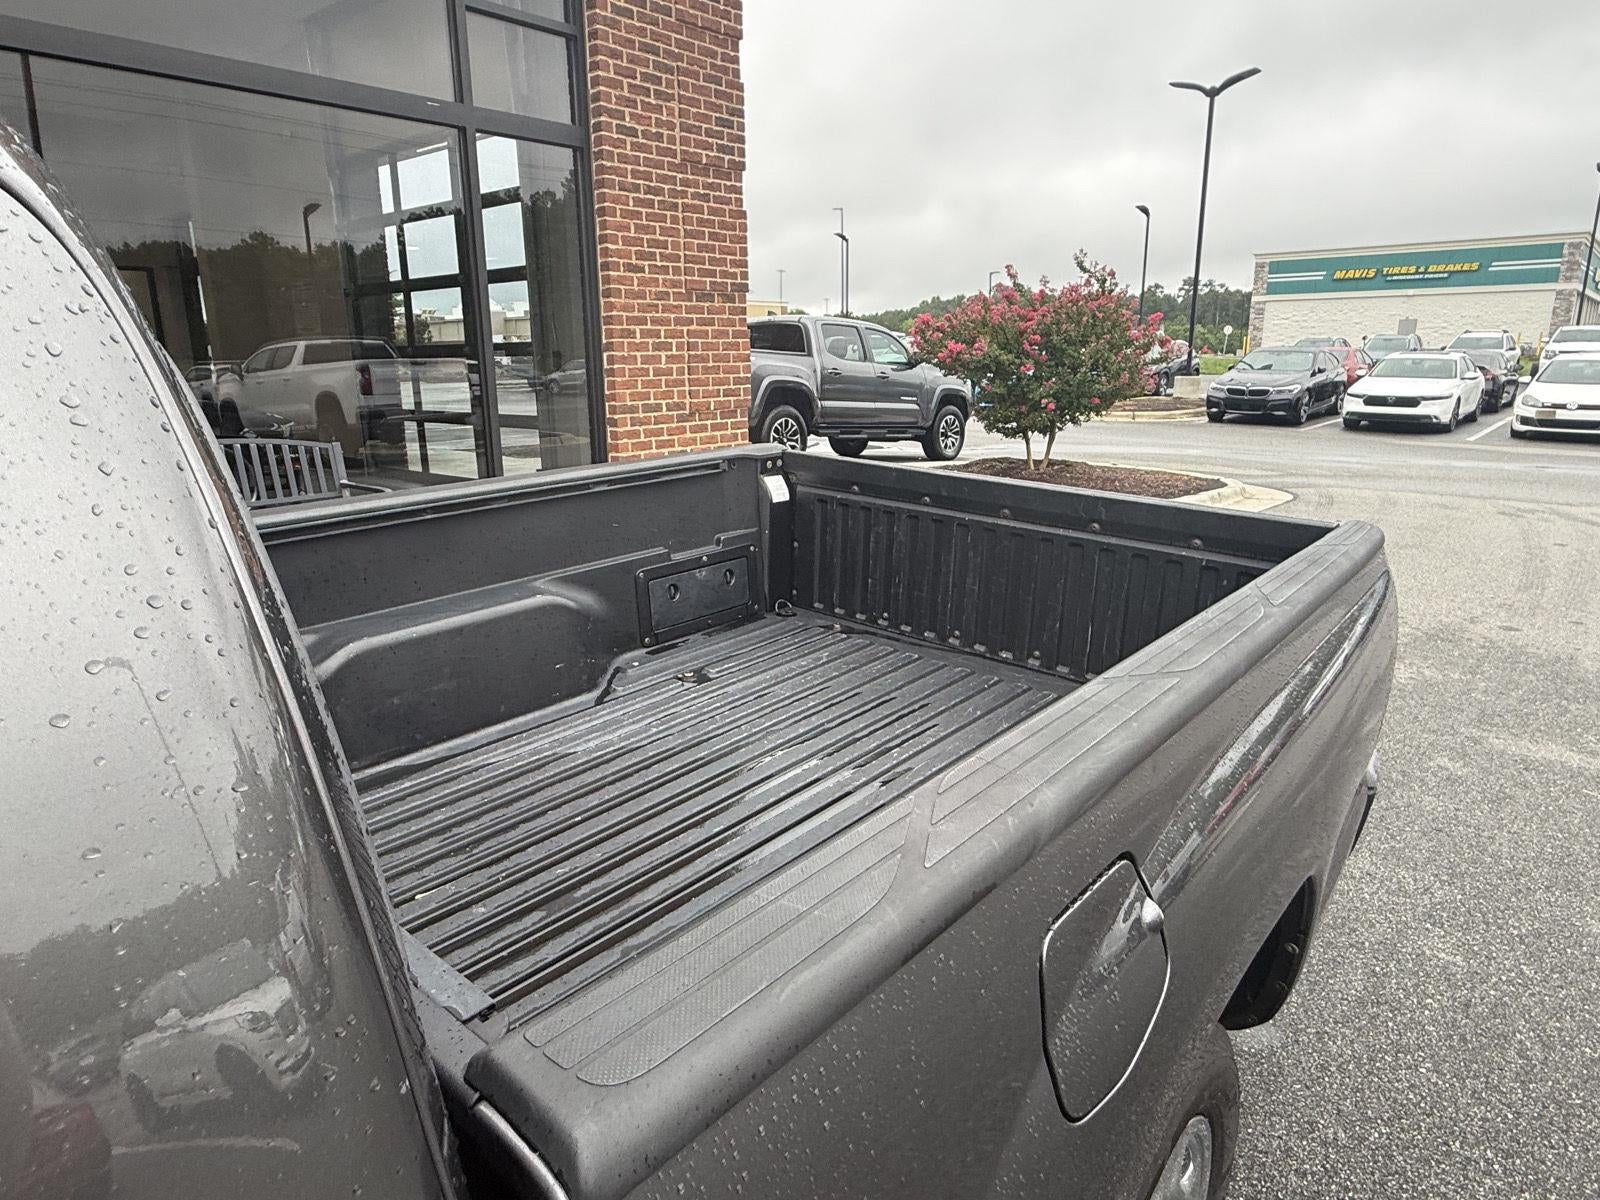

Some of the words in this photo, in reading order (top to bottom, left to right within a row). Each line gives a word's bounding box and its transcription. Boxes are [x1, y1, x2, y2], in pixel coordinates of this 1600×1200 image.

[1333, 268, 1377, 280] MAVIS
[1382, 265, 1417, 275] TIRES
[1418, 265, 1426, 273] &
[1427, 262, 1480, 273] BRAKES
